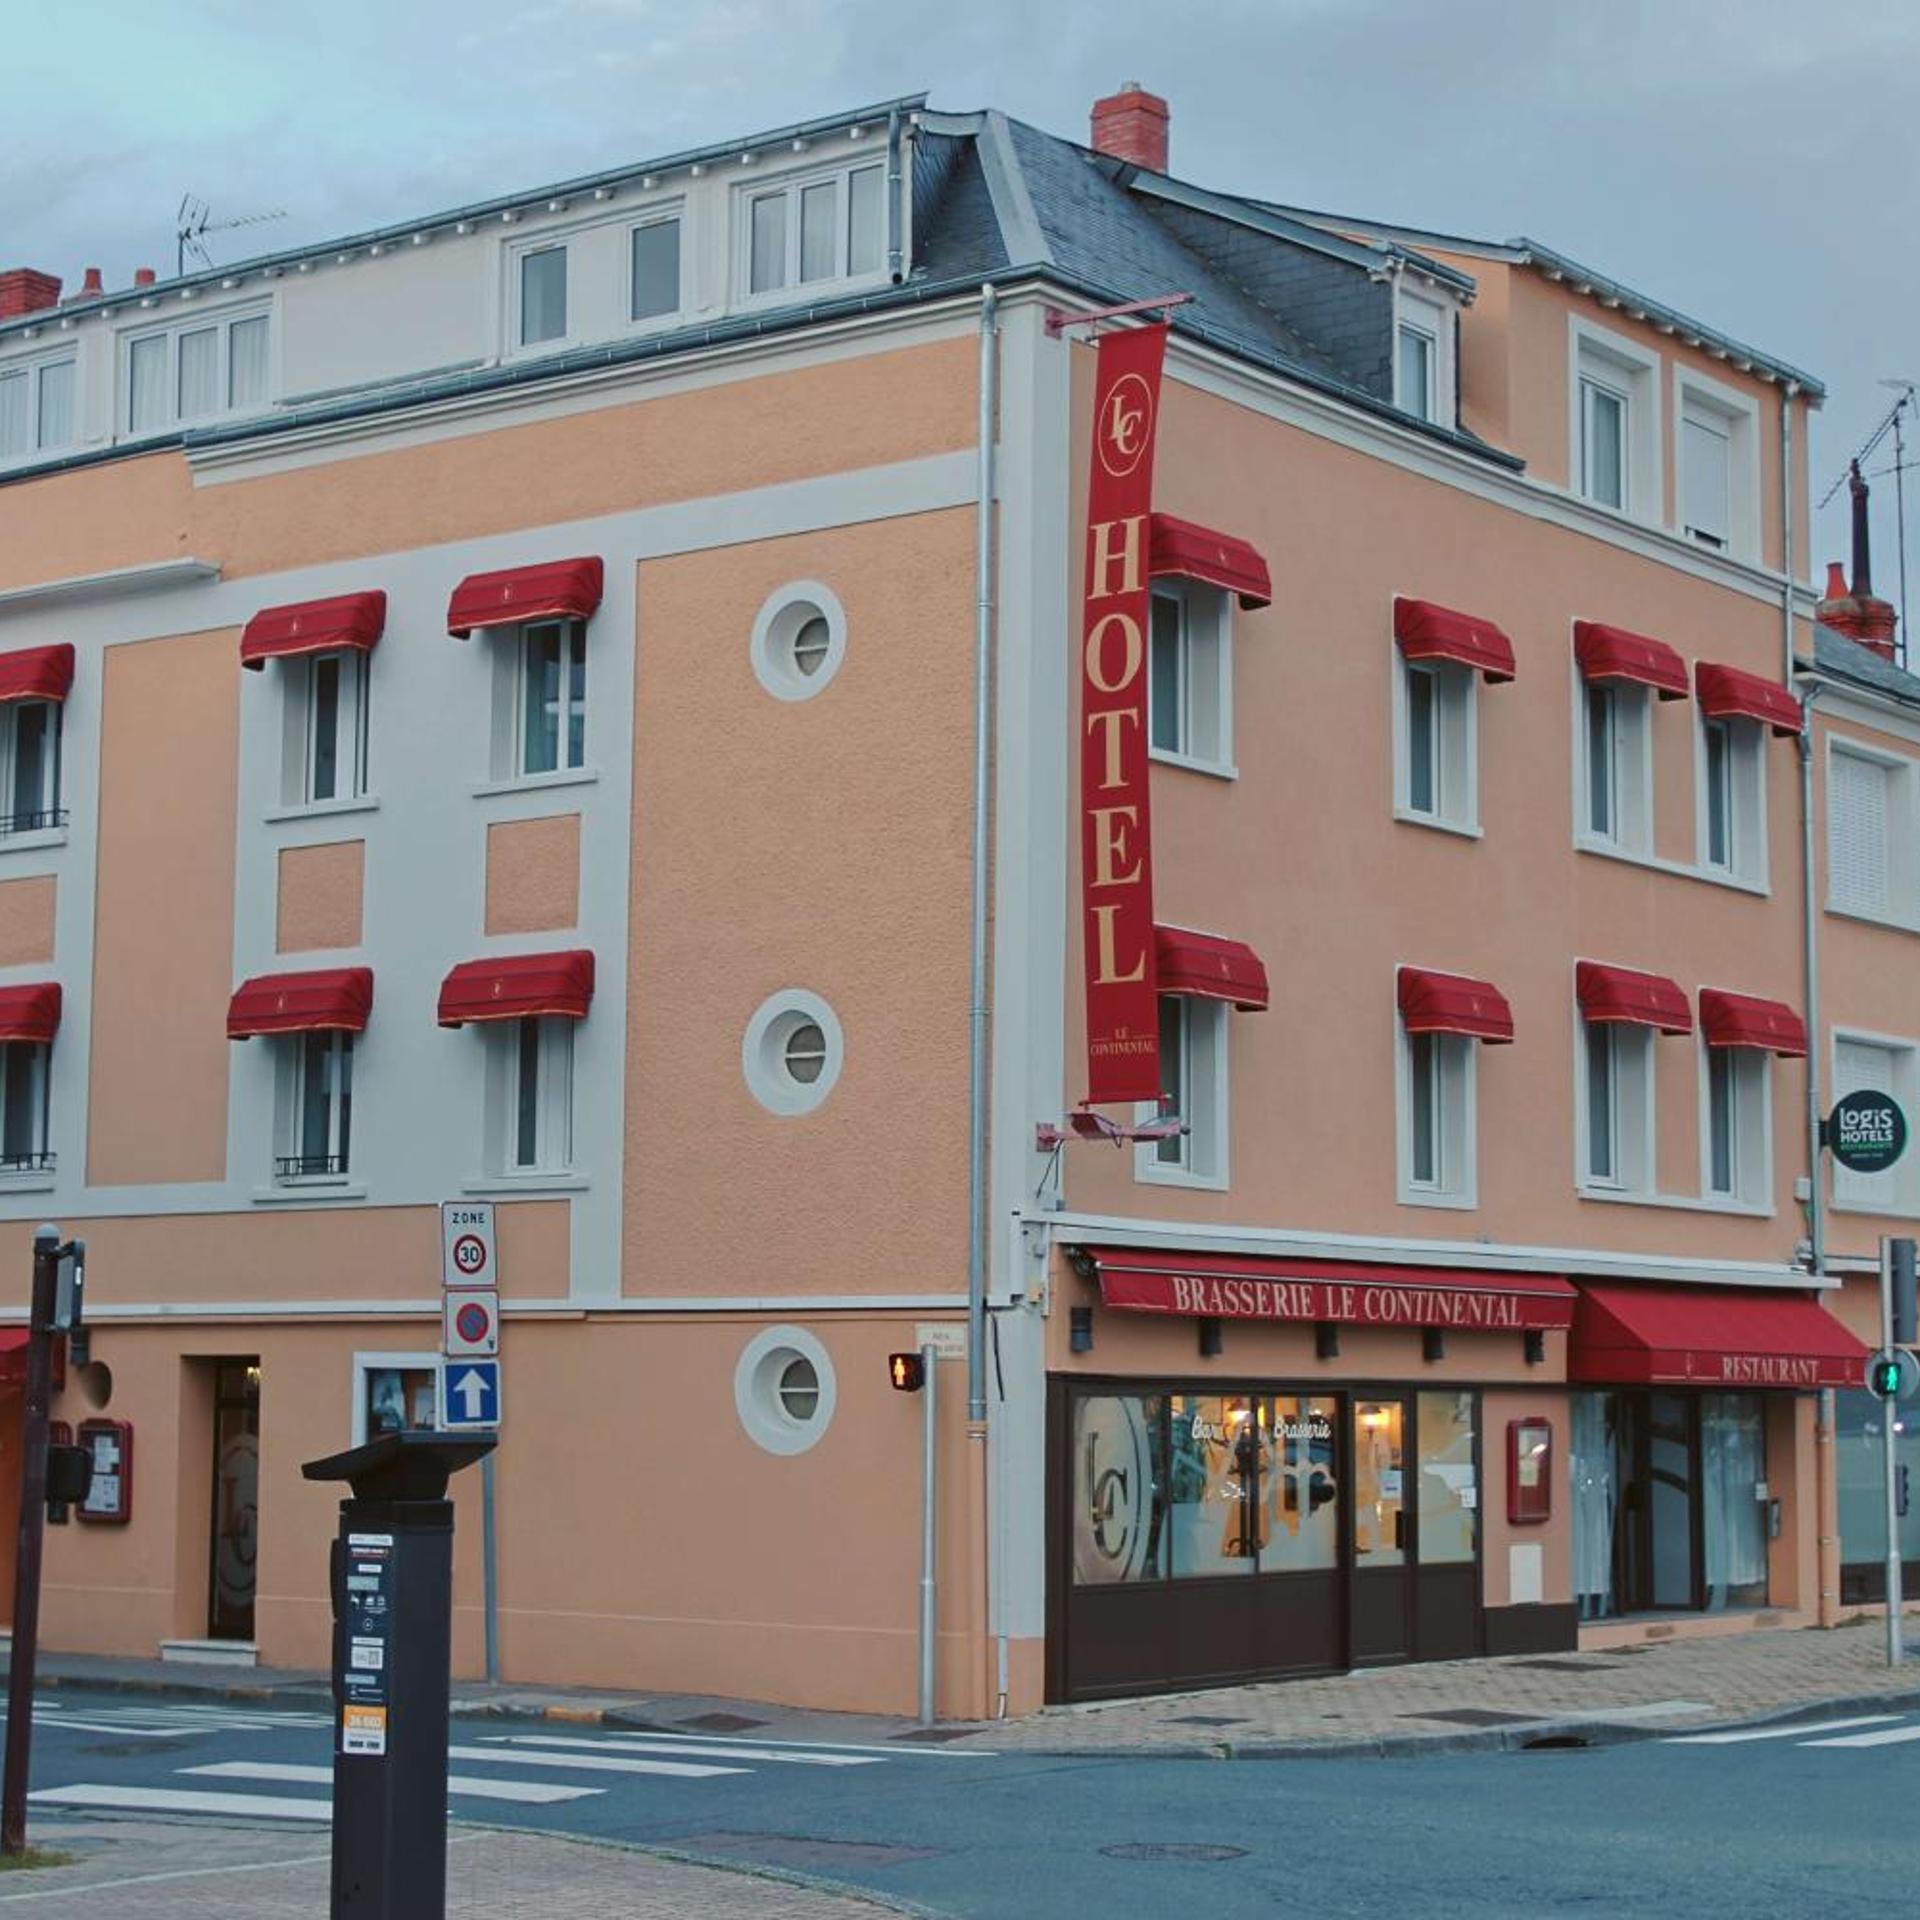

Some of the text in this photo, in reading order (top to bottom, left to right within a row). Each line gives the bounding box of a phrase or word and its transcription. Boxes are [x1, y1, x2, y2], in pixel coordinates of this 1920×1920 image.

[1085, 514, 1147, 985] HOTEL
[1113, 1028, 1129, 1039] LE
[1089, 1039, 1155, 1055] CONTINENTAL
[452, 1212, 485, 1224] ZONE
[460, 1246, 480, 1263] 30
[1172, 1276, 1523, 1327] BRASSERIE LE CONTINENTAL
[1722, 1356, 1819, 1384] RESTAURANT
[1274, 1414, 1332, 1441] Brasserie
